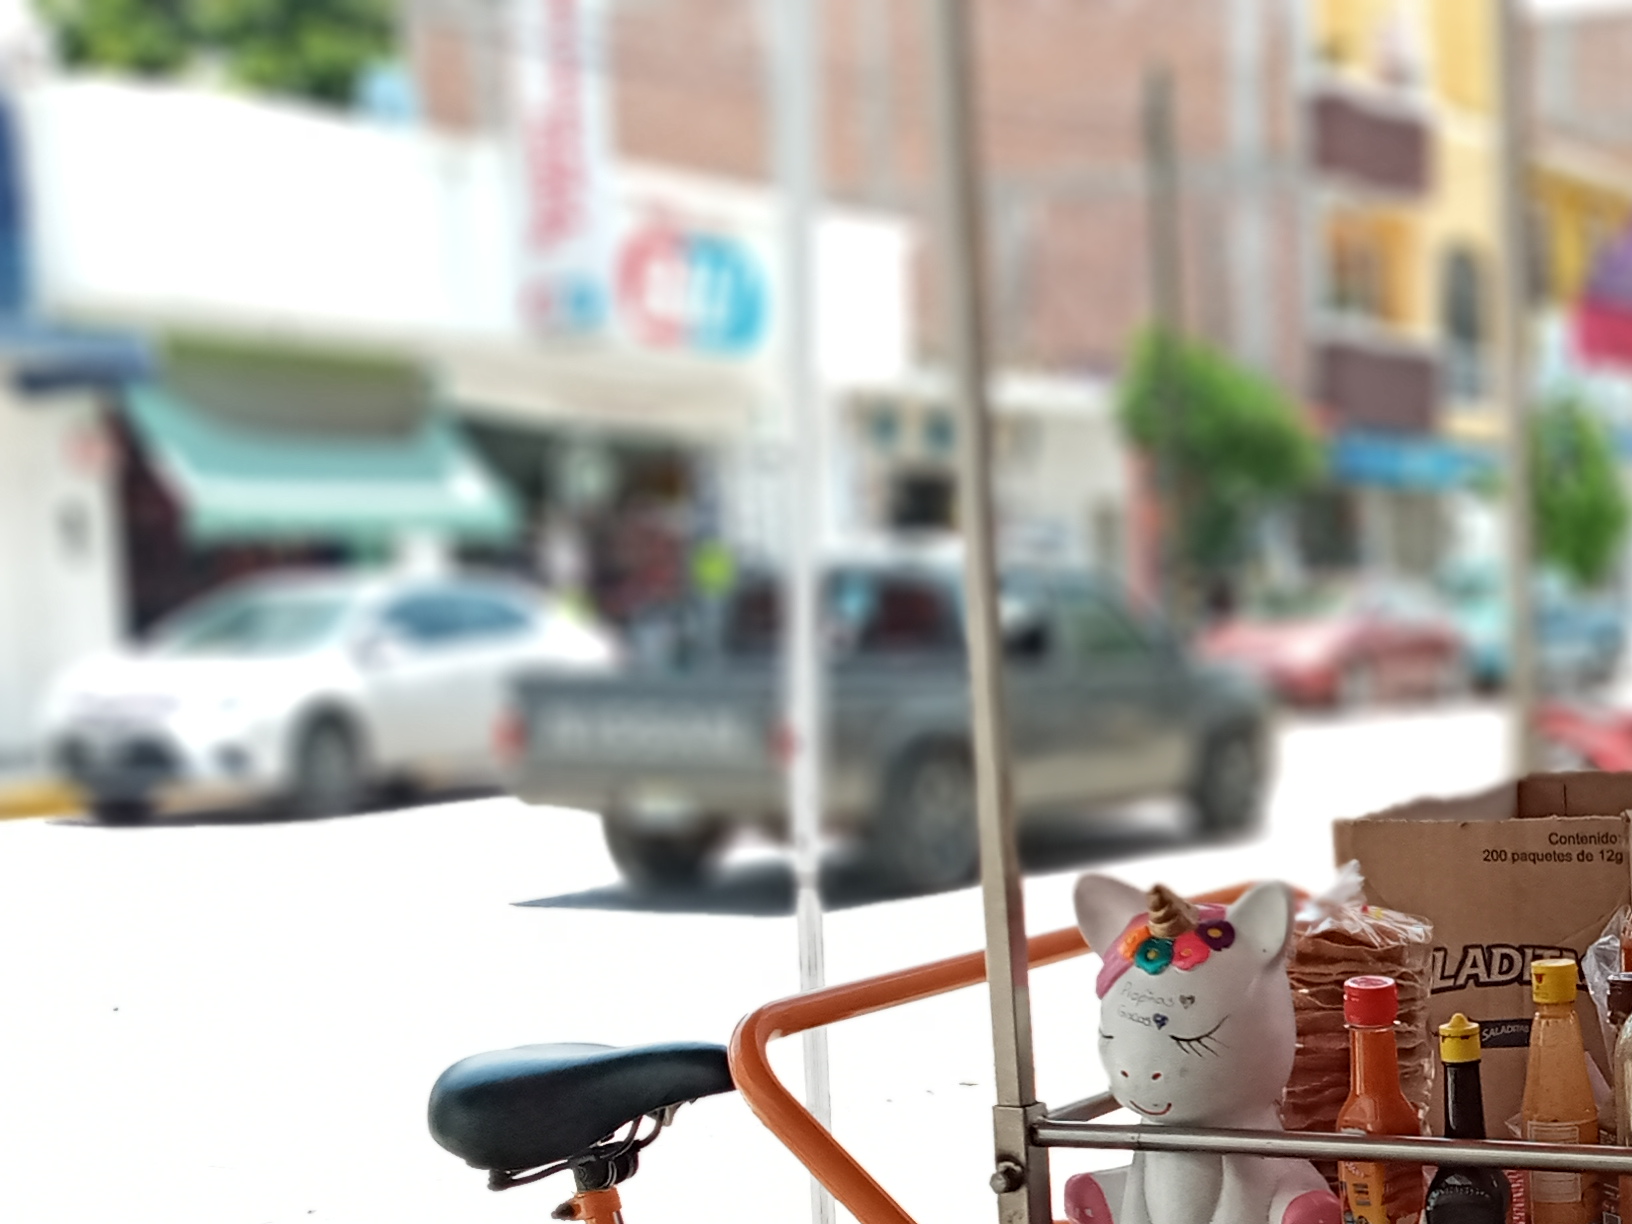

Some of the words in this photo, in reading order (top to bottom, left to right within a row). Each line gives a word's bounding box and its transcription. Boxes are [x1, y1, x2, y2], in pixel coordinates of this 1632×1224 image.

[1482, 848, 1508, 863] 200
[1510, 850, 1573, 866] paquetes
[1576, 849, 1595, 863] de
[1600, 849, 1624, 865] 12g
